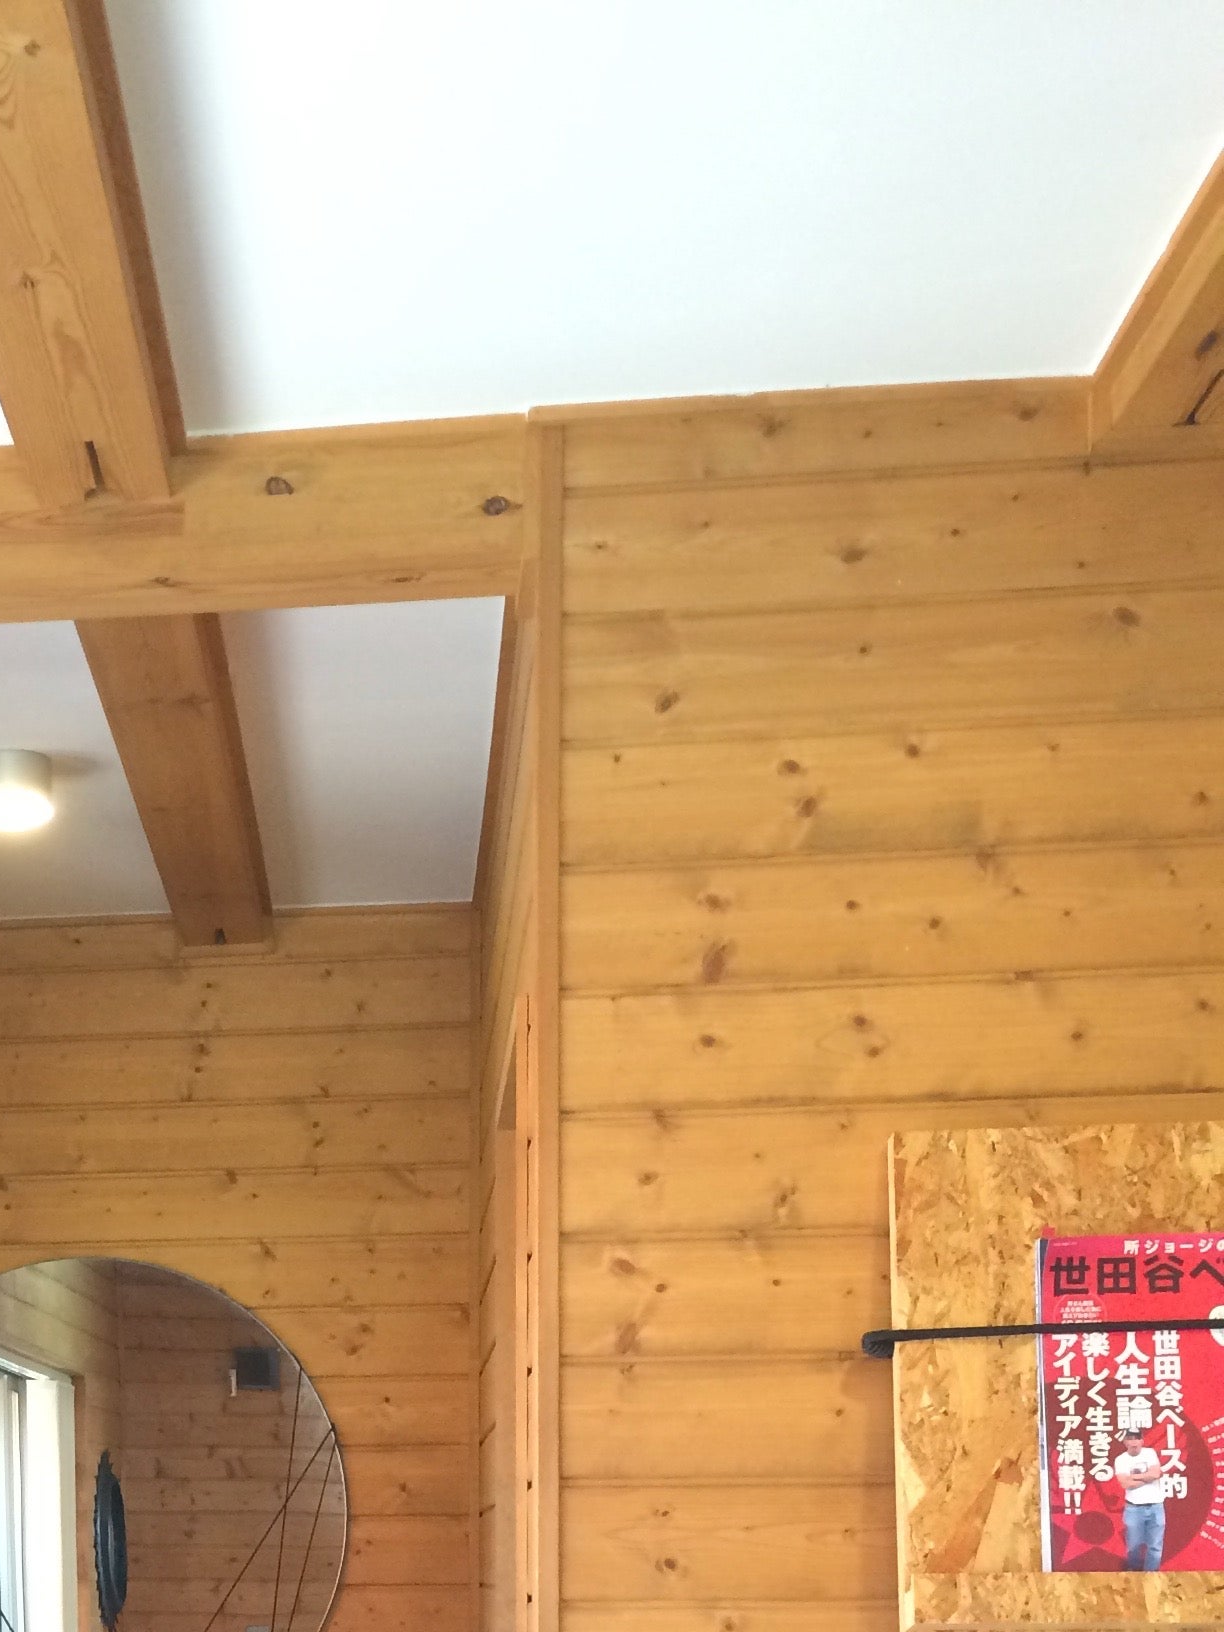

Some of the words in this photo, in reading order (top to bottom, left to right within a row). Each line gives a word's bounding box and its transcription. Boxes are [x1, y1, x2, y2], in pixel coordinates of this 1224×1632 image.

[1081, 1331, 1114, 1482] 楽しく生きる
